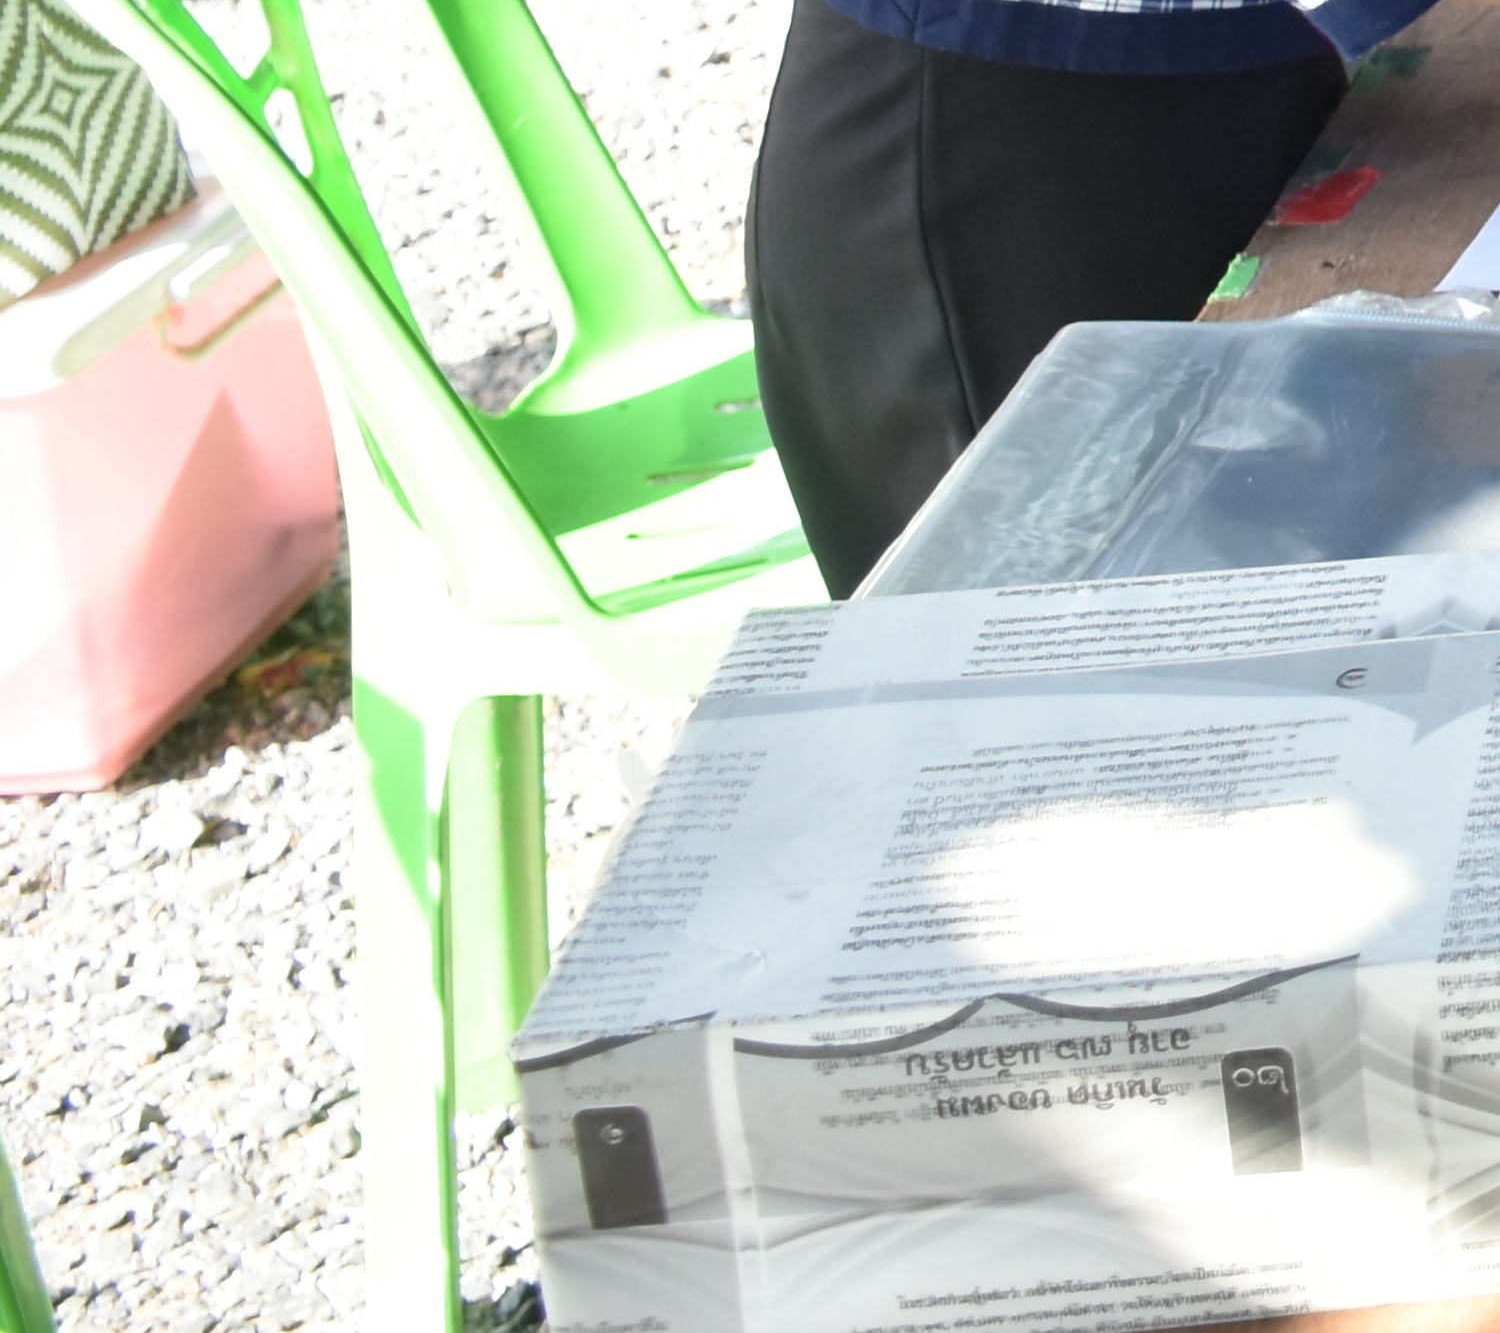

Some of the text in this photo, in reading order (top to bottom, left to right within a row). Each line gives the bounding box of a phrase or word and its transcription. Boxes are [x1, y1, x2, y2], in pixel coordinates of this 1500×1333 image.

[1126, 1020, 1190, 1057] อายุ
[903, 1042, 1042, 1083] แล้วครับ
[935, 1076, 1167, 1119] วันเกิด ของผม
